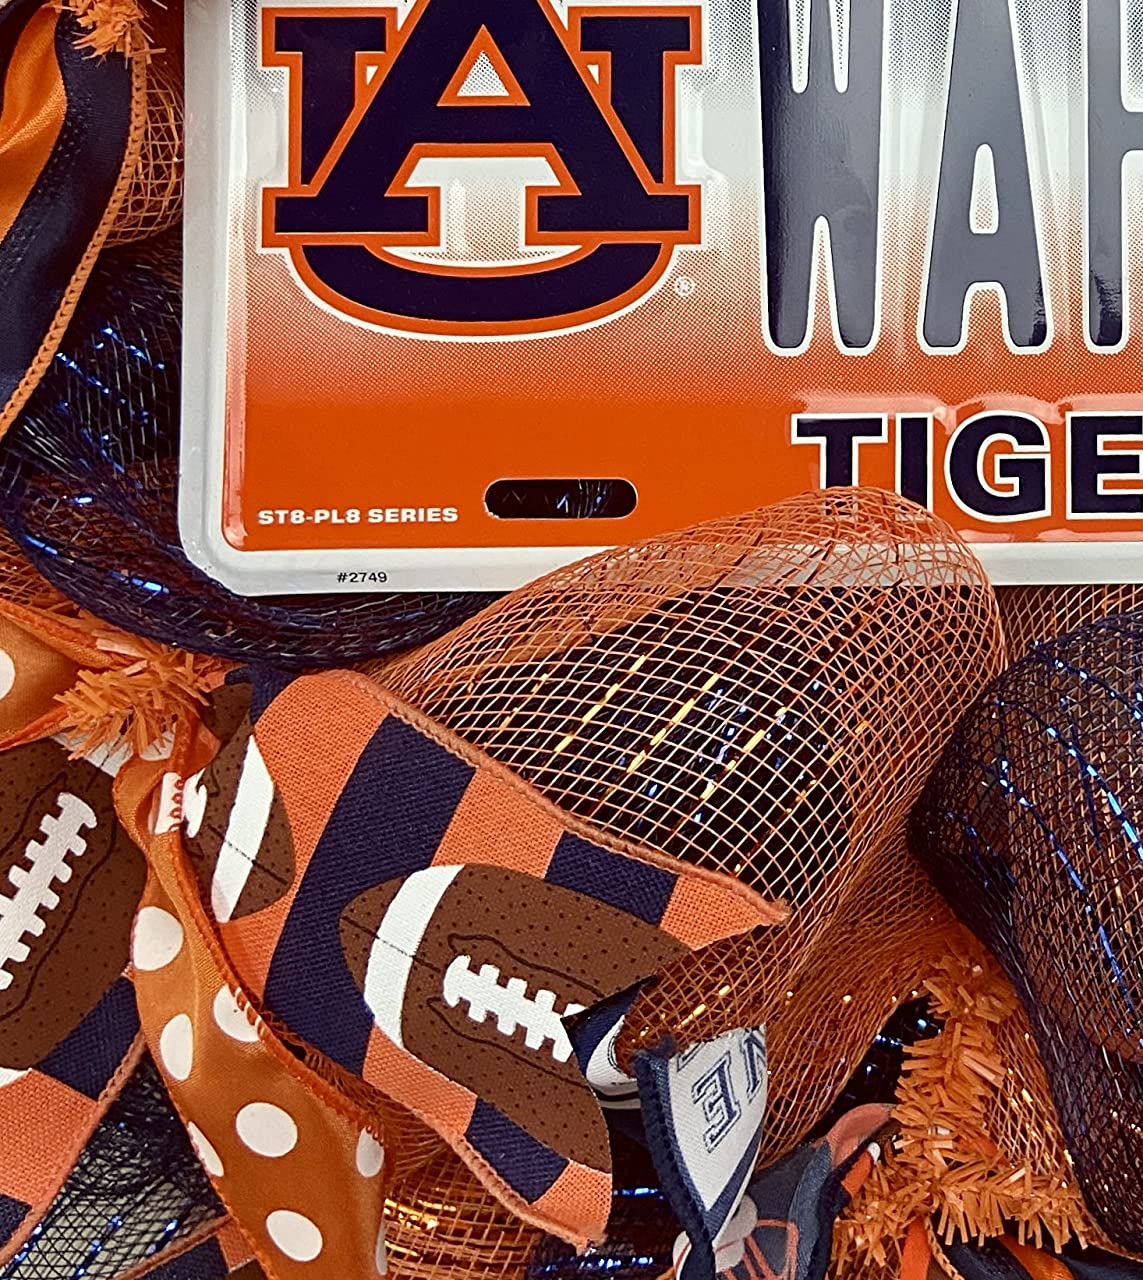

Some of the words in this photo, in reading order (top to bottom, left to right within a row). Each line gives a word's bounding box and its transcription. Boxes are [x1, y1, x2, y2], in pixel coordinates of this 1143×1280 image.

[257, 508, 361, 525] ST8-PL8
[367, 507, 459, 524] SERIES
[336, 571, 388, 584] #2749
